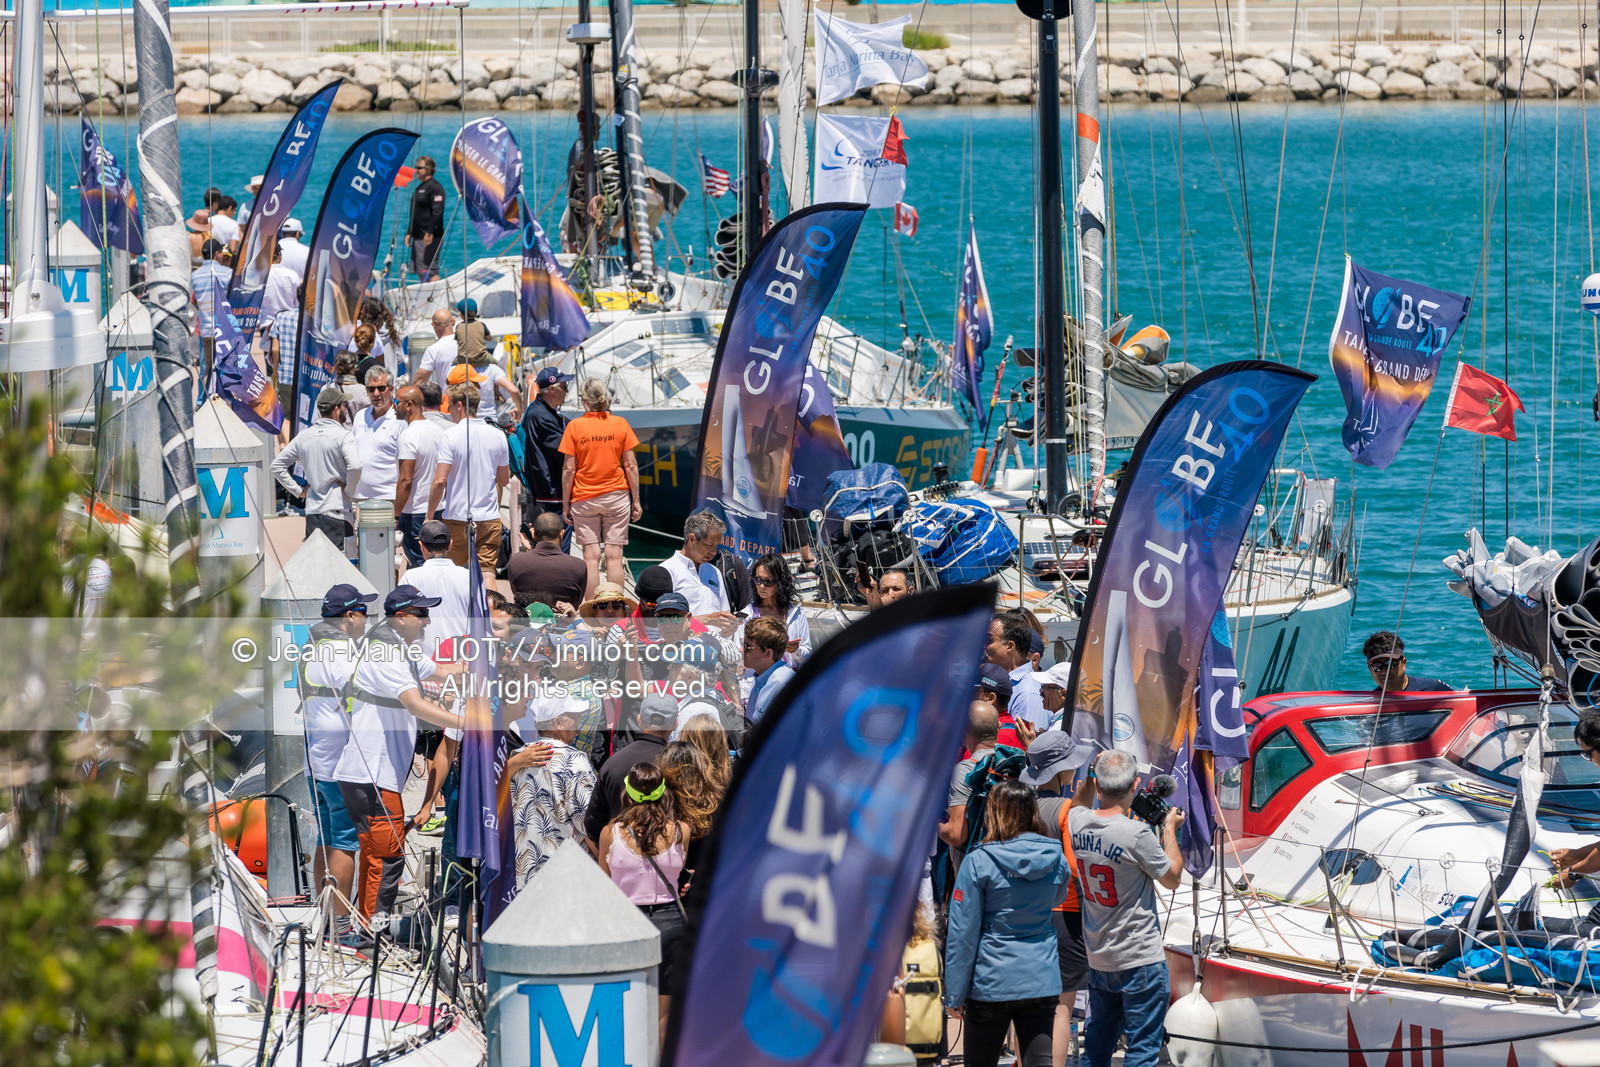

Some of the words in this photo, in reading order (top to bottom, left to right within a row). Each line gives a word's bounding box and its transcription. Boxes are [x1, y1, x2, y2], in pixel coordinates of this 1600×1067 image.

[889, 50, 917, 68] Bay
[743, 246, 804, 395] GLOBE
[800, 225, 836, 281] 40
[1355, 282, 1441, 333] GLOBE
[1393, 337, 1413, 350] ROUTE
[1374, 359, 1410, 380] GRAND
[591, 433, 615, 443] Hayai
[1132, 409, 1226, 609] GLOBE
[1217, 386, 1271, 464] 40
[1256, 626, 1301, 699] 44
[1103, 842, 1125, 866] JR.
[1076, 857, 1120, 909] 13
[517, 980, 632, 1067] M
